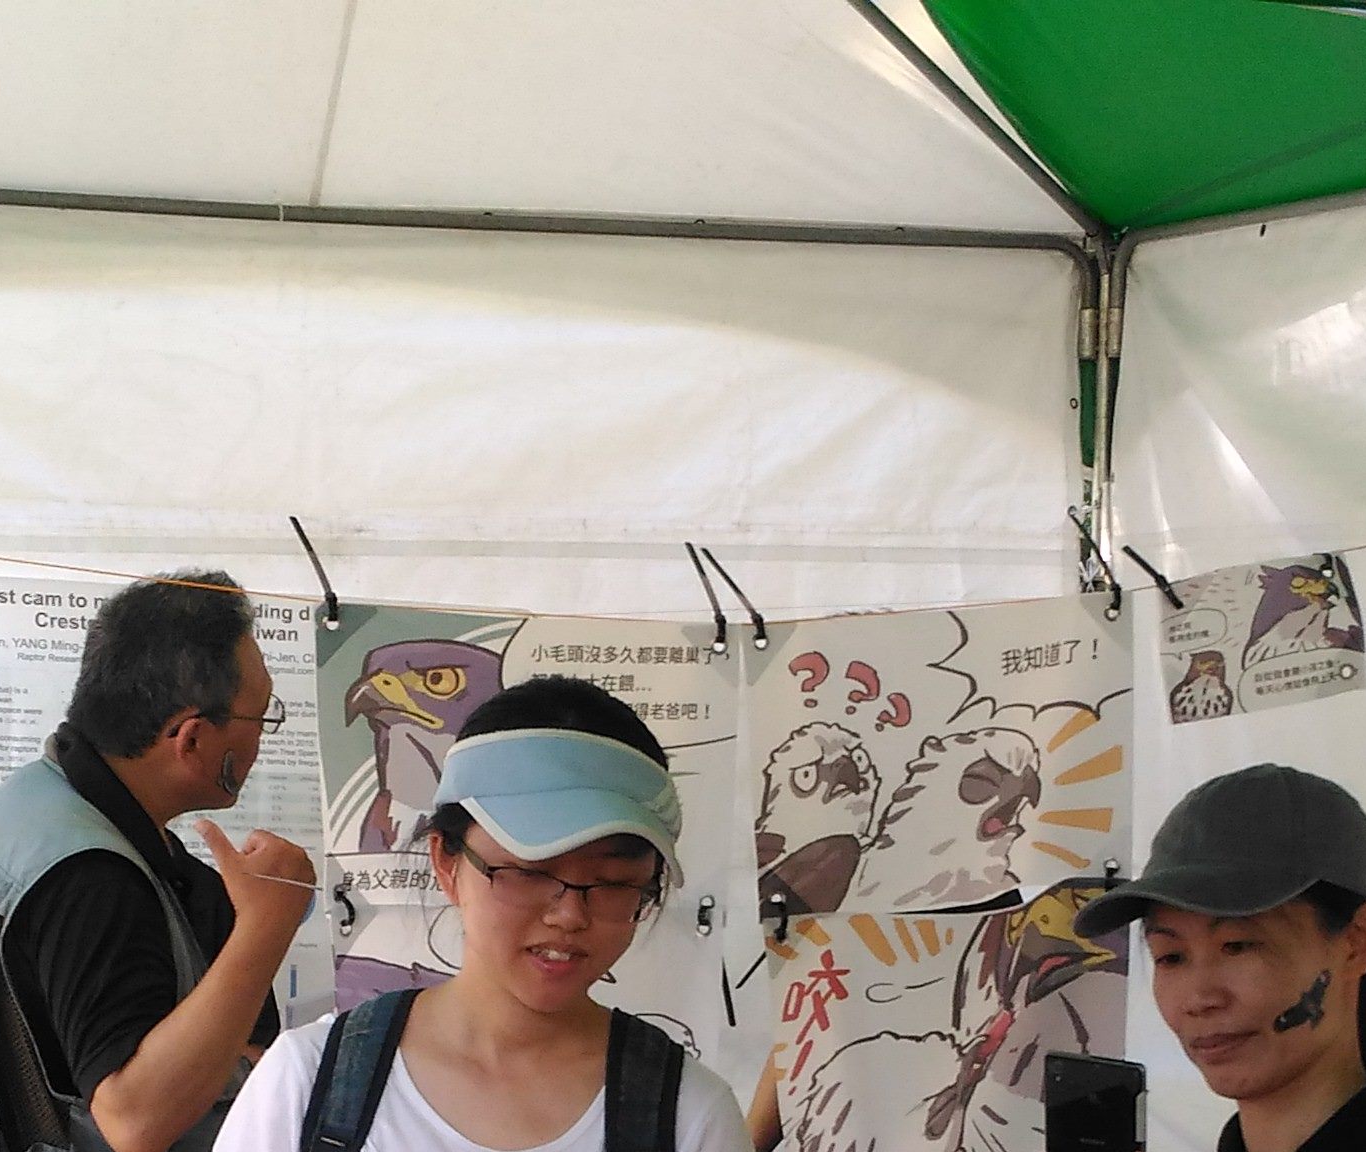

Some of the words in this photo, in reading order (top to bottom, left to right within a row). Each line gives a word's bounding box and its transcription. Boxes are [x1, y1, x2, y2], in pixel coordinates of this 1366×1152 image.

[22, 592, 61, 608] cam
[69, 592, 87, 609] to
[253, 604, 292, 623] ding
[256, 624, 298, 641] iwan
[12, 638, 48, 650] YANG
[51, 640, 84, 653] Ming-
[48, 654, 82, 663] Resear
[1001, 639, 1098, 676] 我知道了！
